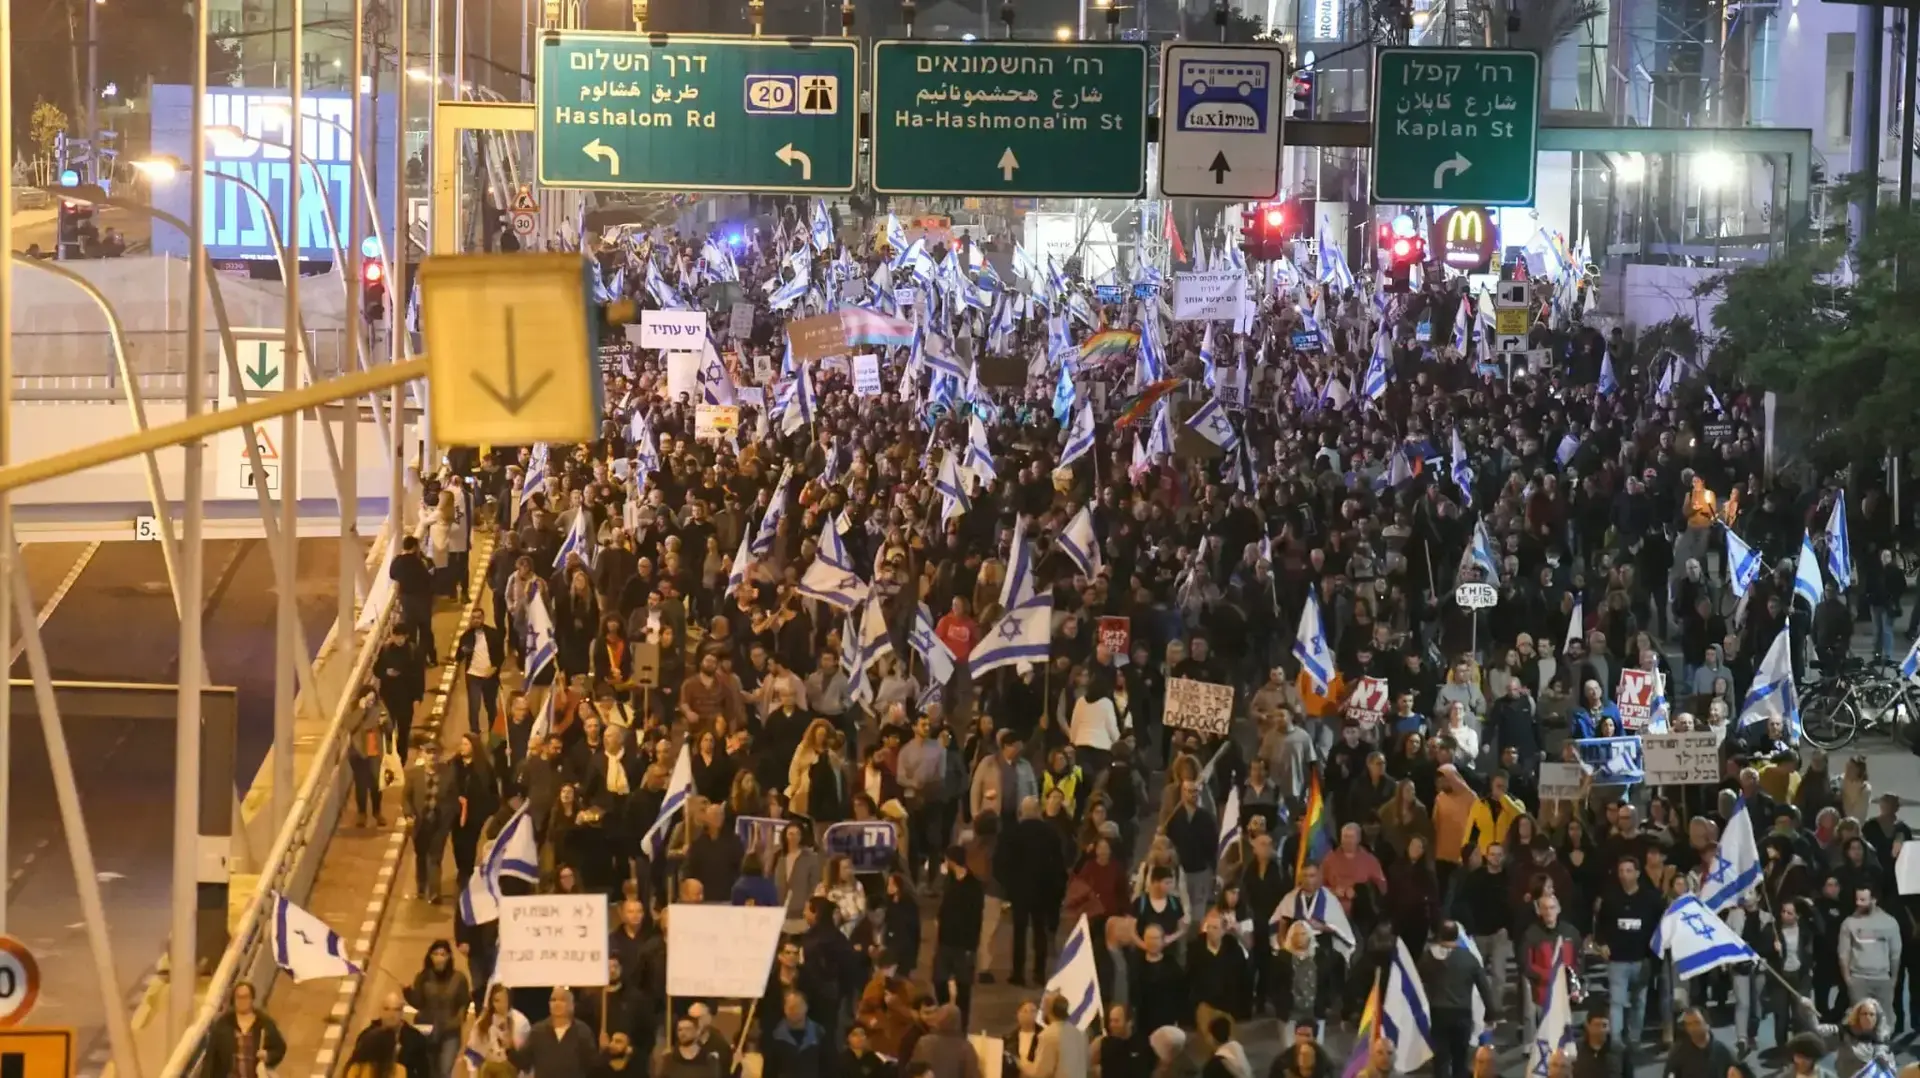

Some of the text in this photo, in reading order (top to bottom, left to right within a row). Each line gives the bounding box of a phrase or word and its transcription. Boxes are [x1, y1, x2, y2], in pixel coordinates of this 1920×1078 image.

[570, 49, 708, 77] דרך השלום
[916, 55, 1053, 74] החשמונאים
[1402, 60, 1462, 87] קפלן
[651, 83, 699, 104] طريق
[758, 86, 785, 103] 20
[1052, 86, 1104, 109] شارع
[1465, 93, 1518, 117] شارع
[555, 106, 716, 128] Hashalom Rd
[895, 110, 1123, 130] Ha-Hashmona'im St
[1190, 110, 1256, 127] taxi מונית
[1396, 119, 1514, 140] Kaplan St
[516, 219, 530, 229] 30
[649, 324, 701, 336] יש עתיד
[1457, 596, 1470, 604] IS
[1460, 586, 1492, 596] THIS
[1350, 680, 1389, 713] לא
[1206, 707, 1222, 717] OF
[863, 826, 890, 848] רק
[512, 901, 595, 922] לא אשתוק
[525, 925, 564, 938] ארצי
[0, 966, 16, 998] 0
